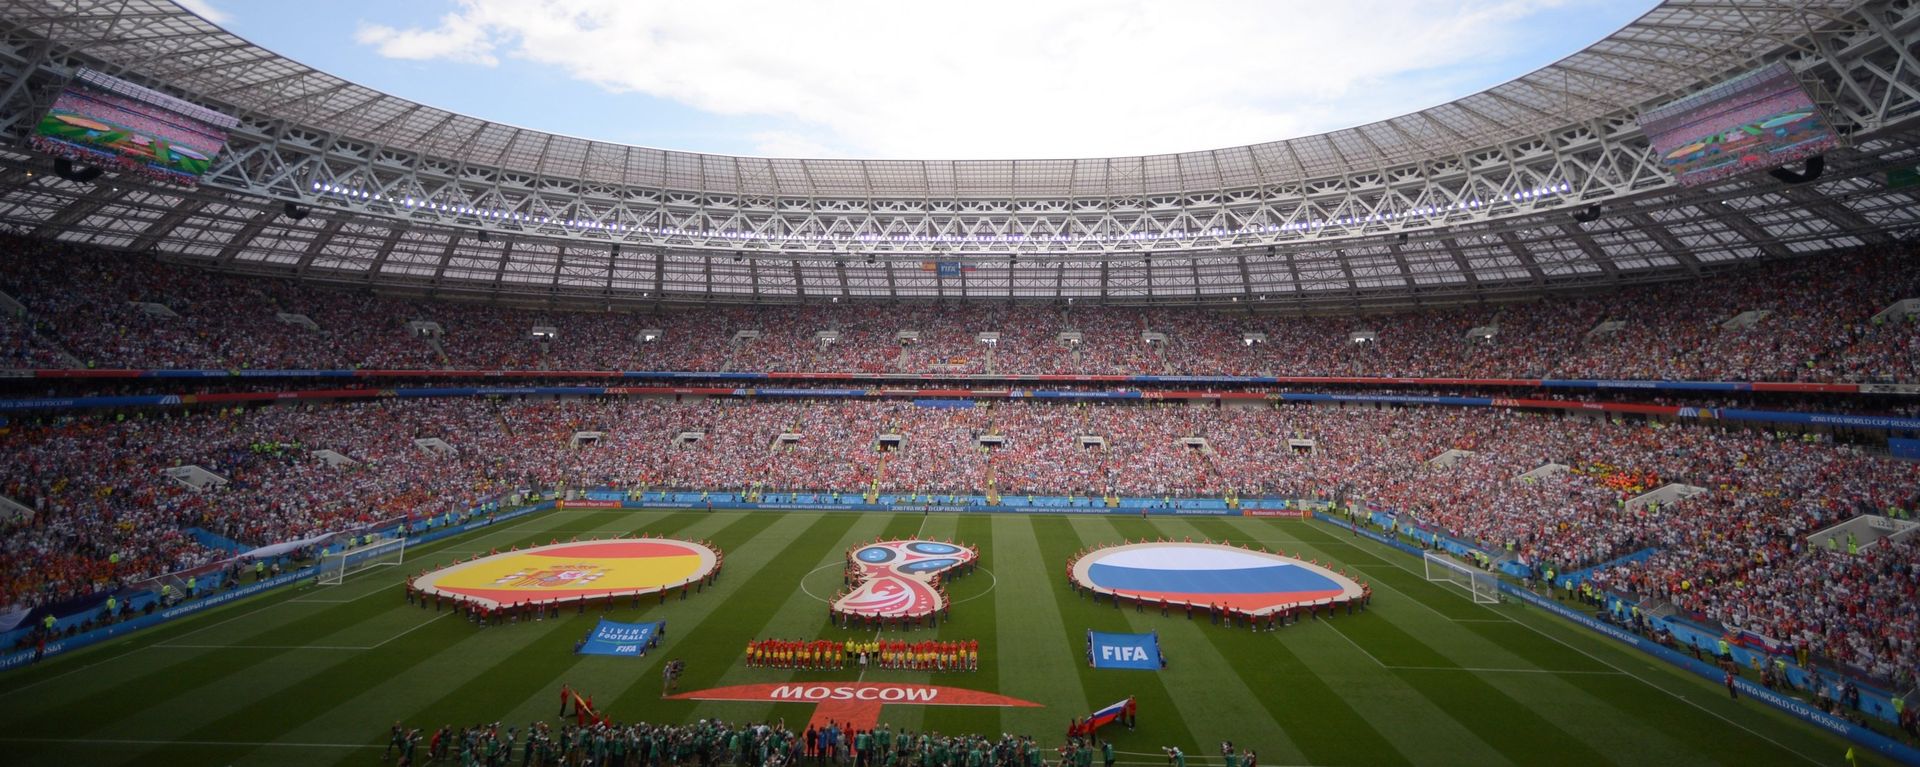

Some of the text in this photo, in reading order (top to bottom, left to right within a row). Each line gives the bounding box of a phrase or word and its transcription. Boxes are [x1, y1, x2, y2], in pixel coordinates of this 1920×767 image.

[1844, 417, 1871, 425] WORLD
[601, 626, 649, 635] LIVING
[598, 632, 644, 641] FOOTBALL
[616, 645, 637, 653] FIFA
[1102, 645, 1149, 661] FIFA
[770, 685, 938, 701] MOSCOW
[1742, 682, 1759, 697] FIFA
[1759, 690, 1790, 709] WORLD
[1790, 703, 1809, 716] CUP
[1810, 711, 1848, 734] RUSSIA
